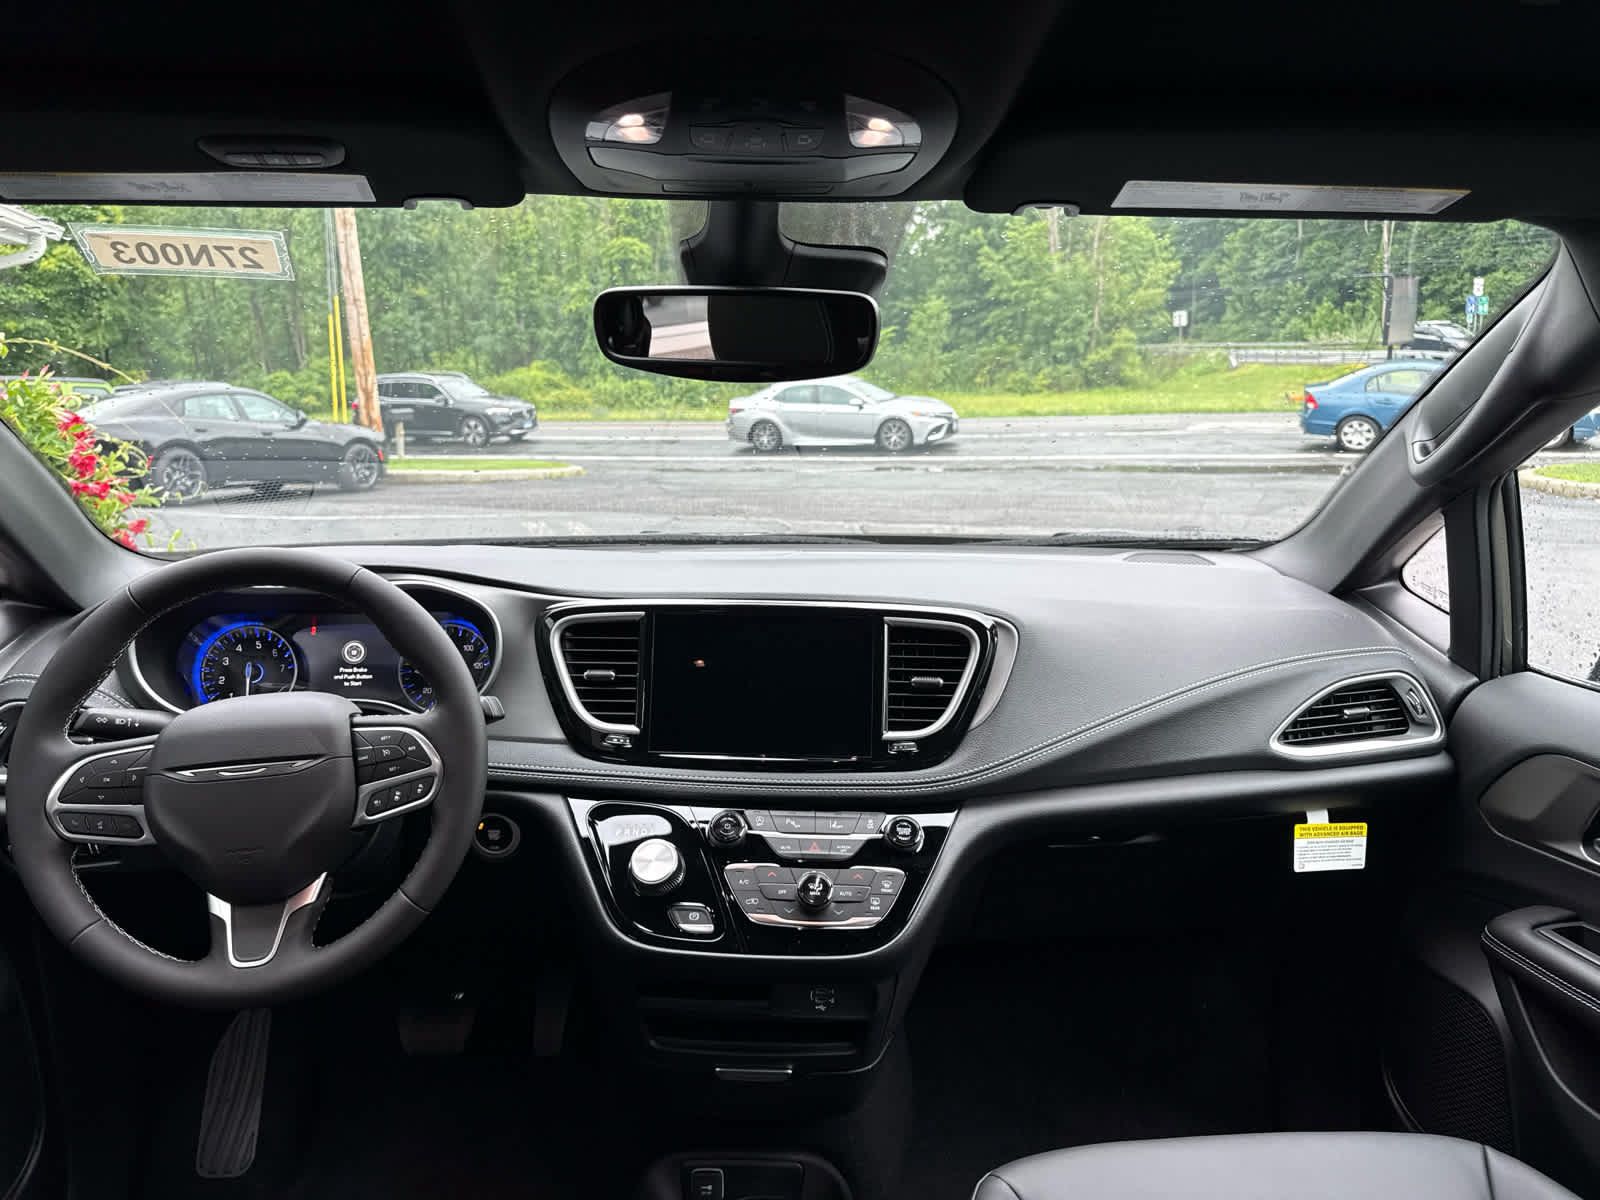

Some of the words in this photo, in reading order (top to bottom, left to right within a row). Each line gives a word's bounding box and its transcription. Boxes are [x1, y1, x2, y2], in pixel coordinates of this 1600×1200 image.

[235, 643, 243, 653] 4
[255, 640, 263, 650] 5
[272, 648, 278, 657] 6
[222, 656, 229, 666] 3
[218, 676, 226, 685] 2
